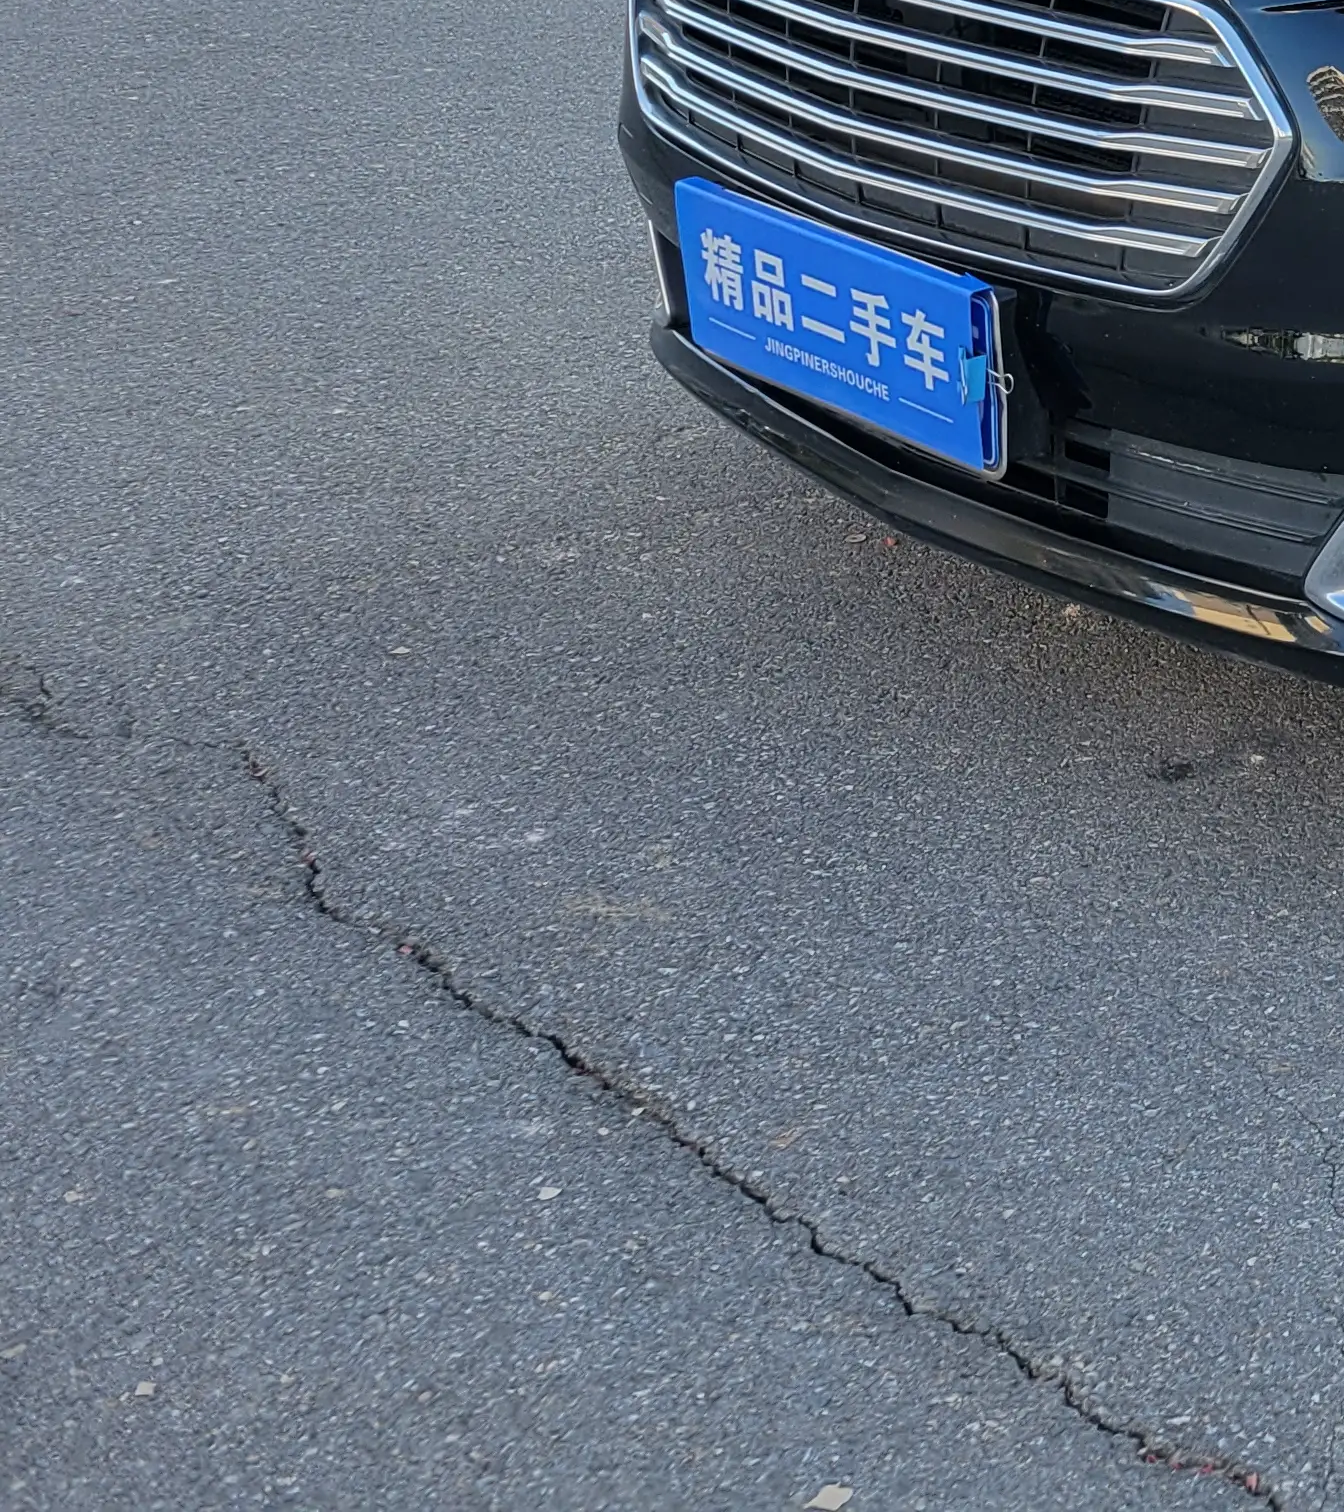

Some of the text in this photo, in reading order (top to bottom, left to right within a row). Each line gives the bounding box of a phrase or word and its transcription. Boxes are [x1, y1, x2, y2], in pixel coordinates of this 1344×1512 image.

[700, 228, 949, 391] 精品二手车
[764, 336, 891, 402] JINGPINERSHOUCHE
